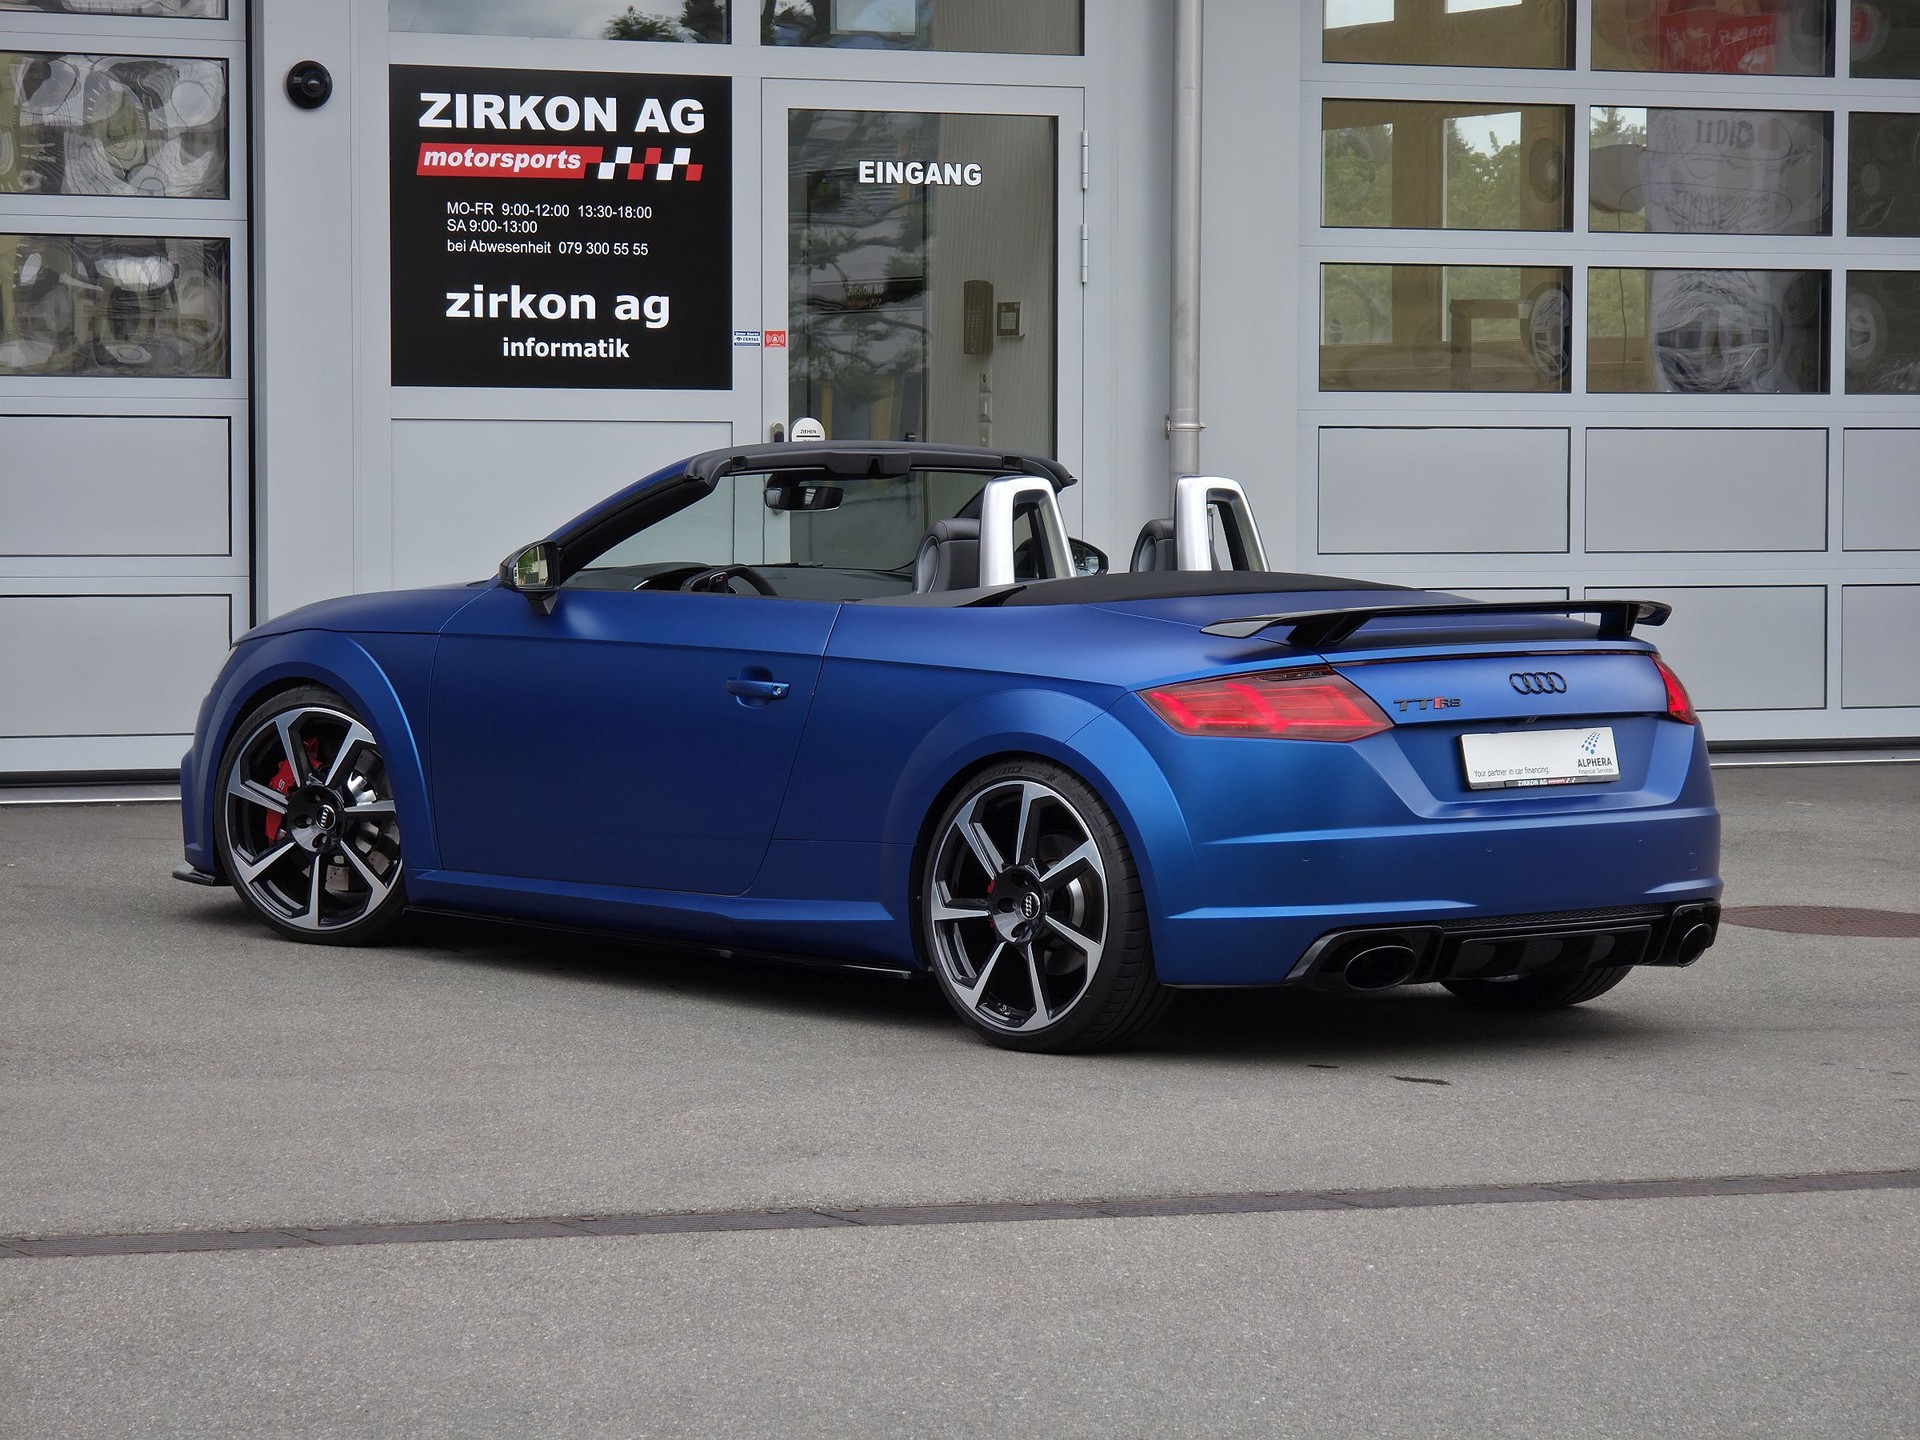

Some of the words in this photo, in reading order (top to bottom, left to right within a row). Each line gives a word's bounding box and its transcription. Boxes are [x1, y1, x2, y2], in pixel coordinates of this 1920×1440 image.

[418, 92, 617, 132] ZIRKON
[634, 97, 705, 134] AG
[423, 148, 582, 173] motorsports
[859, 161, 982, 186] EINGANG
[446, 201, 494, 216] MO-FR
[501, 203, 570, 217] 9:00-12:00
[577, 205, 653, 219] 13:30-18:00
[446, 219, 467, 232] SA
[469, 219, 538, 233] 9:00-13:00
[447, 239, 467, 252] bei
[469, 239, 552, 254] Abwesenheit
[558, 241, 582, 254] 079
[586, 241, 610, 255] 300
[613, 242, 629, 255] 55
[632, 243, 649, 256] 55
[445, 284, 596, 320] zirkon
[614, 293, 670, 329] ag
[503, 336, 630, 359] informatik
[1474, 769, 1487, 777] Your
[1487, 768, 1508, 777] partner
[1577, 757, 1613, 768] ALPHERA
